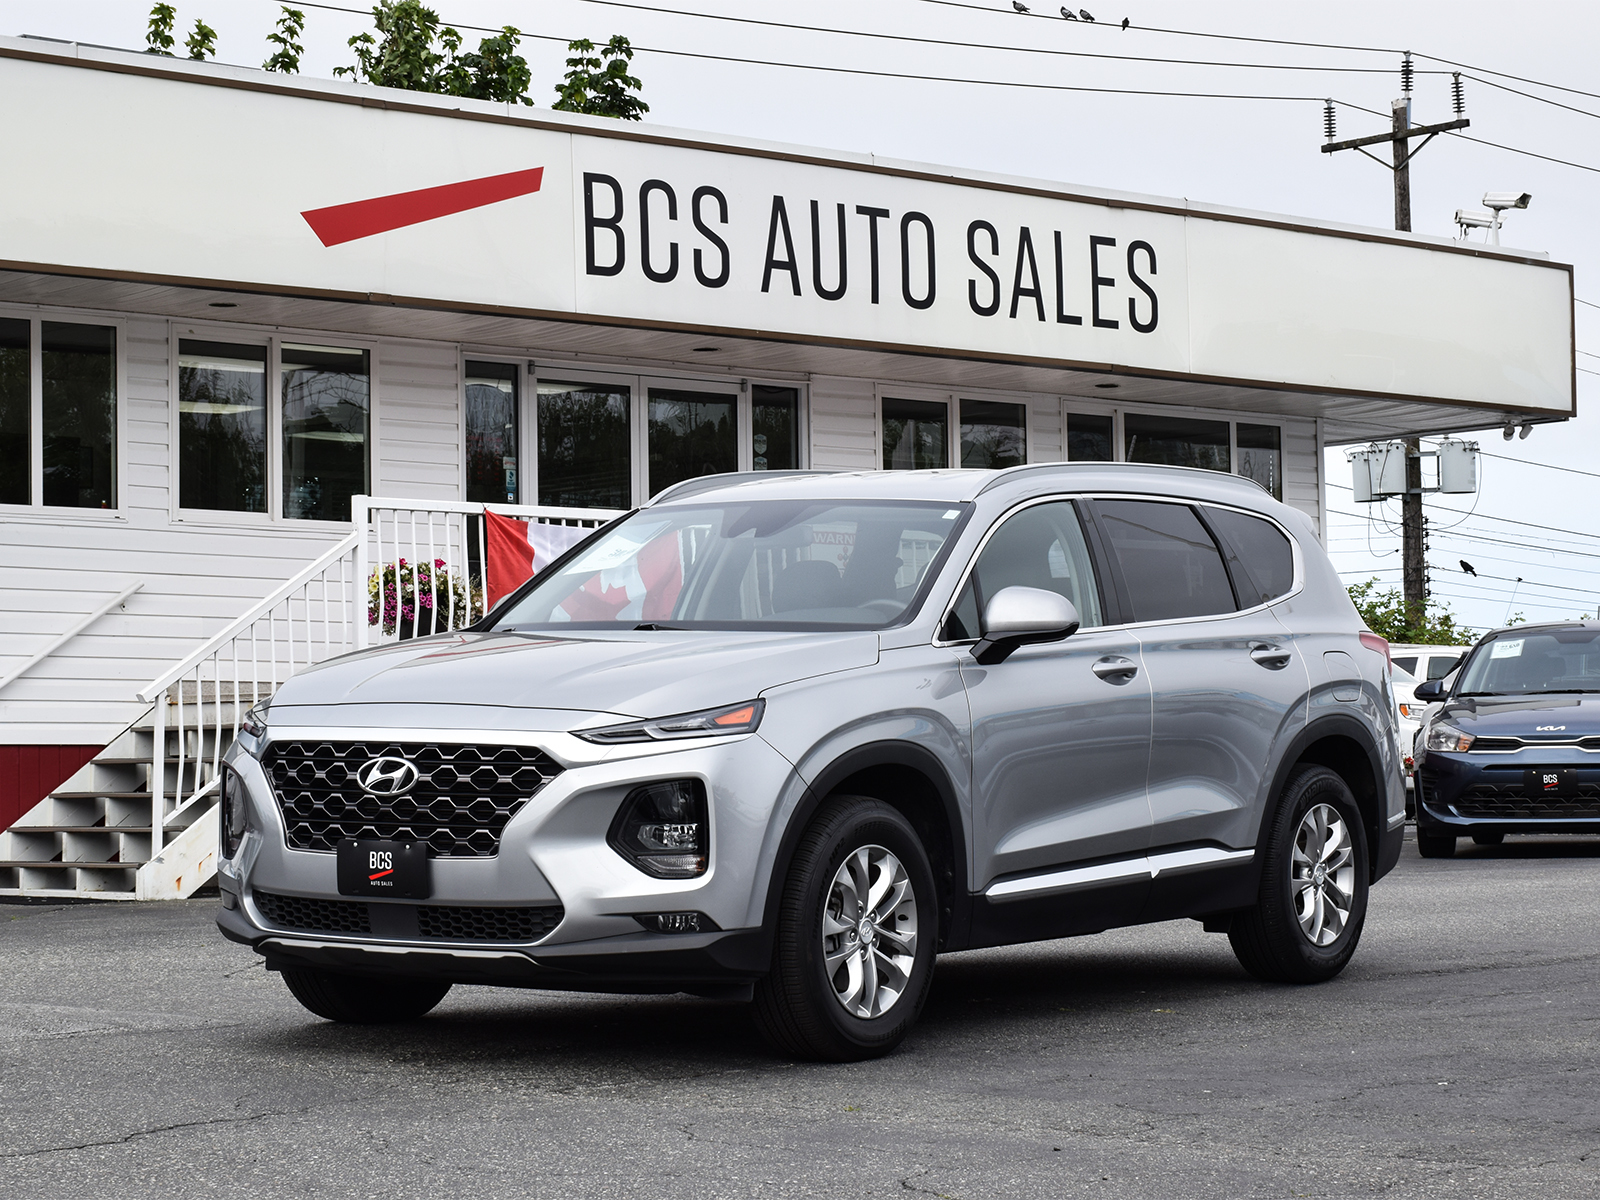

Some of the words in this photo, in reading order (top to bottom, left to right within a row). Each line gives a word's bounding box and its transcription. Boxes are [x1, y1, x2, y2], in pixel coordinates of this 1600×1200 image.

[583, 172, 730, 289] BCS
[761, 194, 936, 310] AUTO
[966, 219, 1159, 334] SALES
[1543, 774, 1558, 784] BCS
[369, 851, 392, 869] BCS
